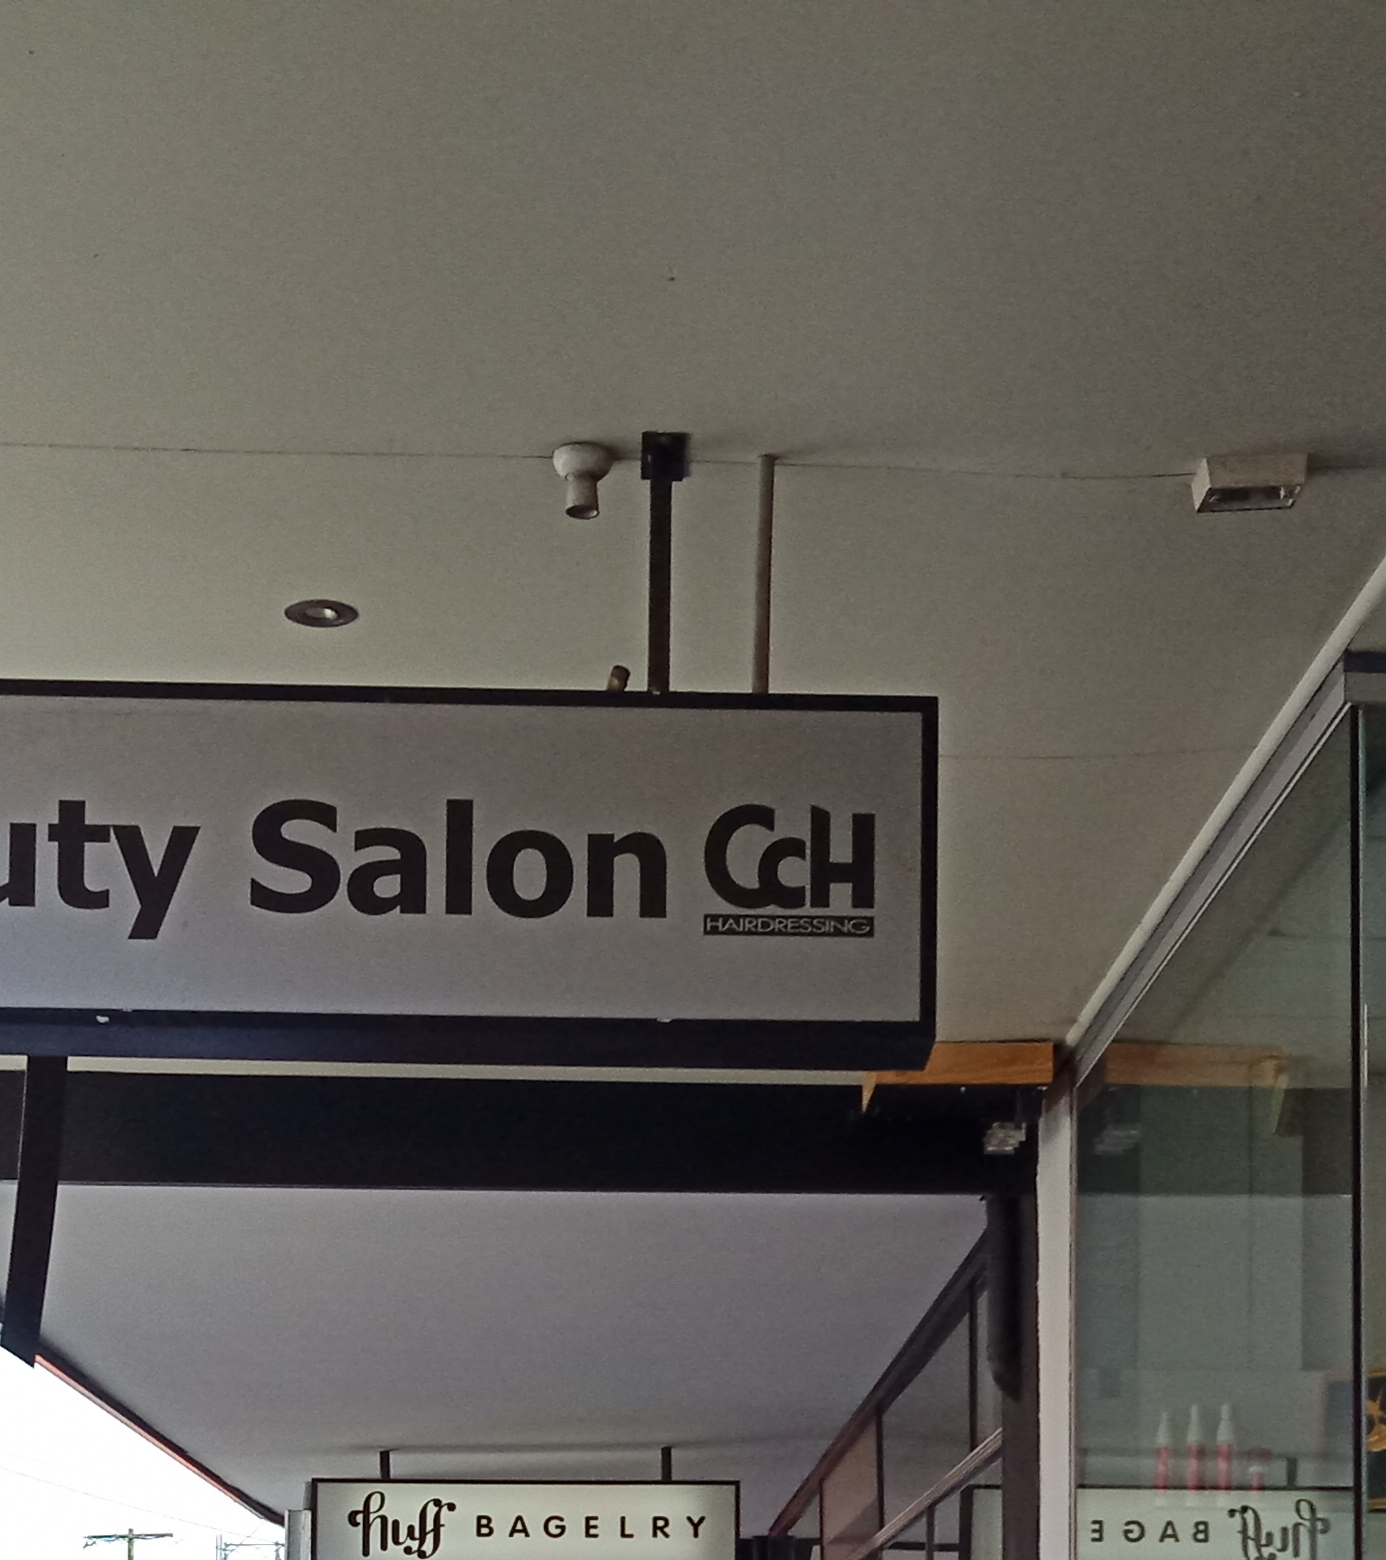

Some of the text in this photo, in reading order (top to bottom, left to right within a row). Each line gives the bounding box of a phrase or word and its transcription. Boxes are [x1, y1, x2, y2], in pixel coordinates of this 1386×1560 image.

[249, 798, 668, 919] Salon
[704, 915, 873, 936] HAIRDRESSING
[347, 1490, 707, 1560] huff BAGELRY
